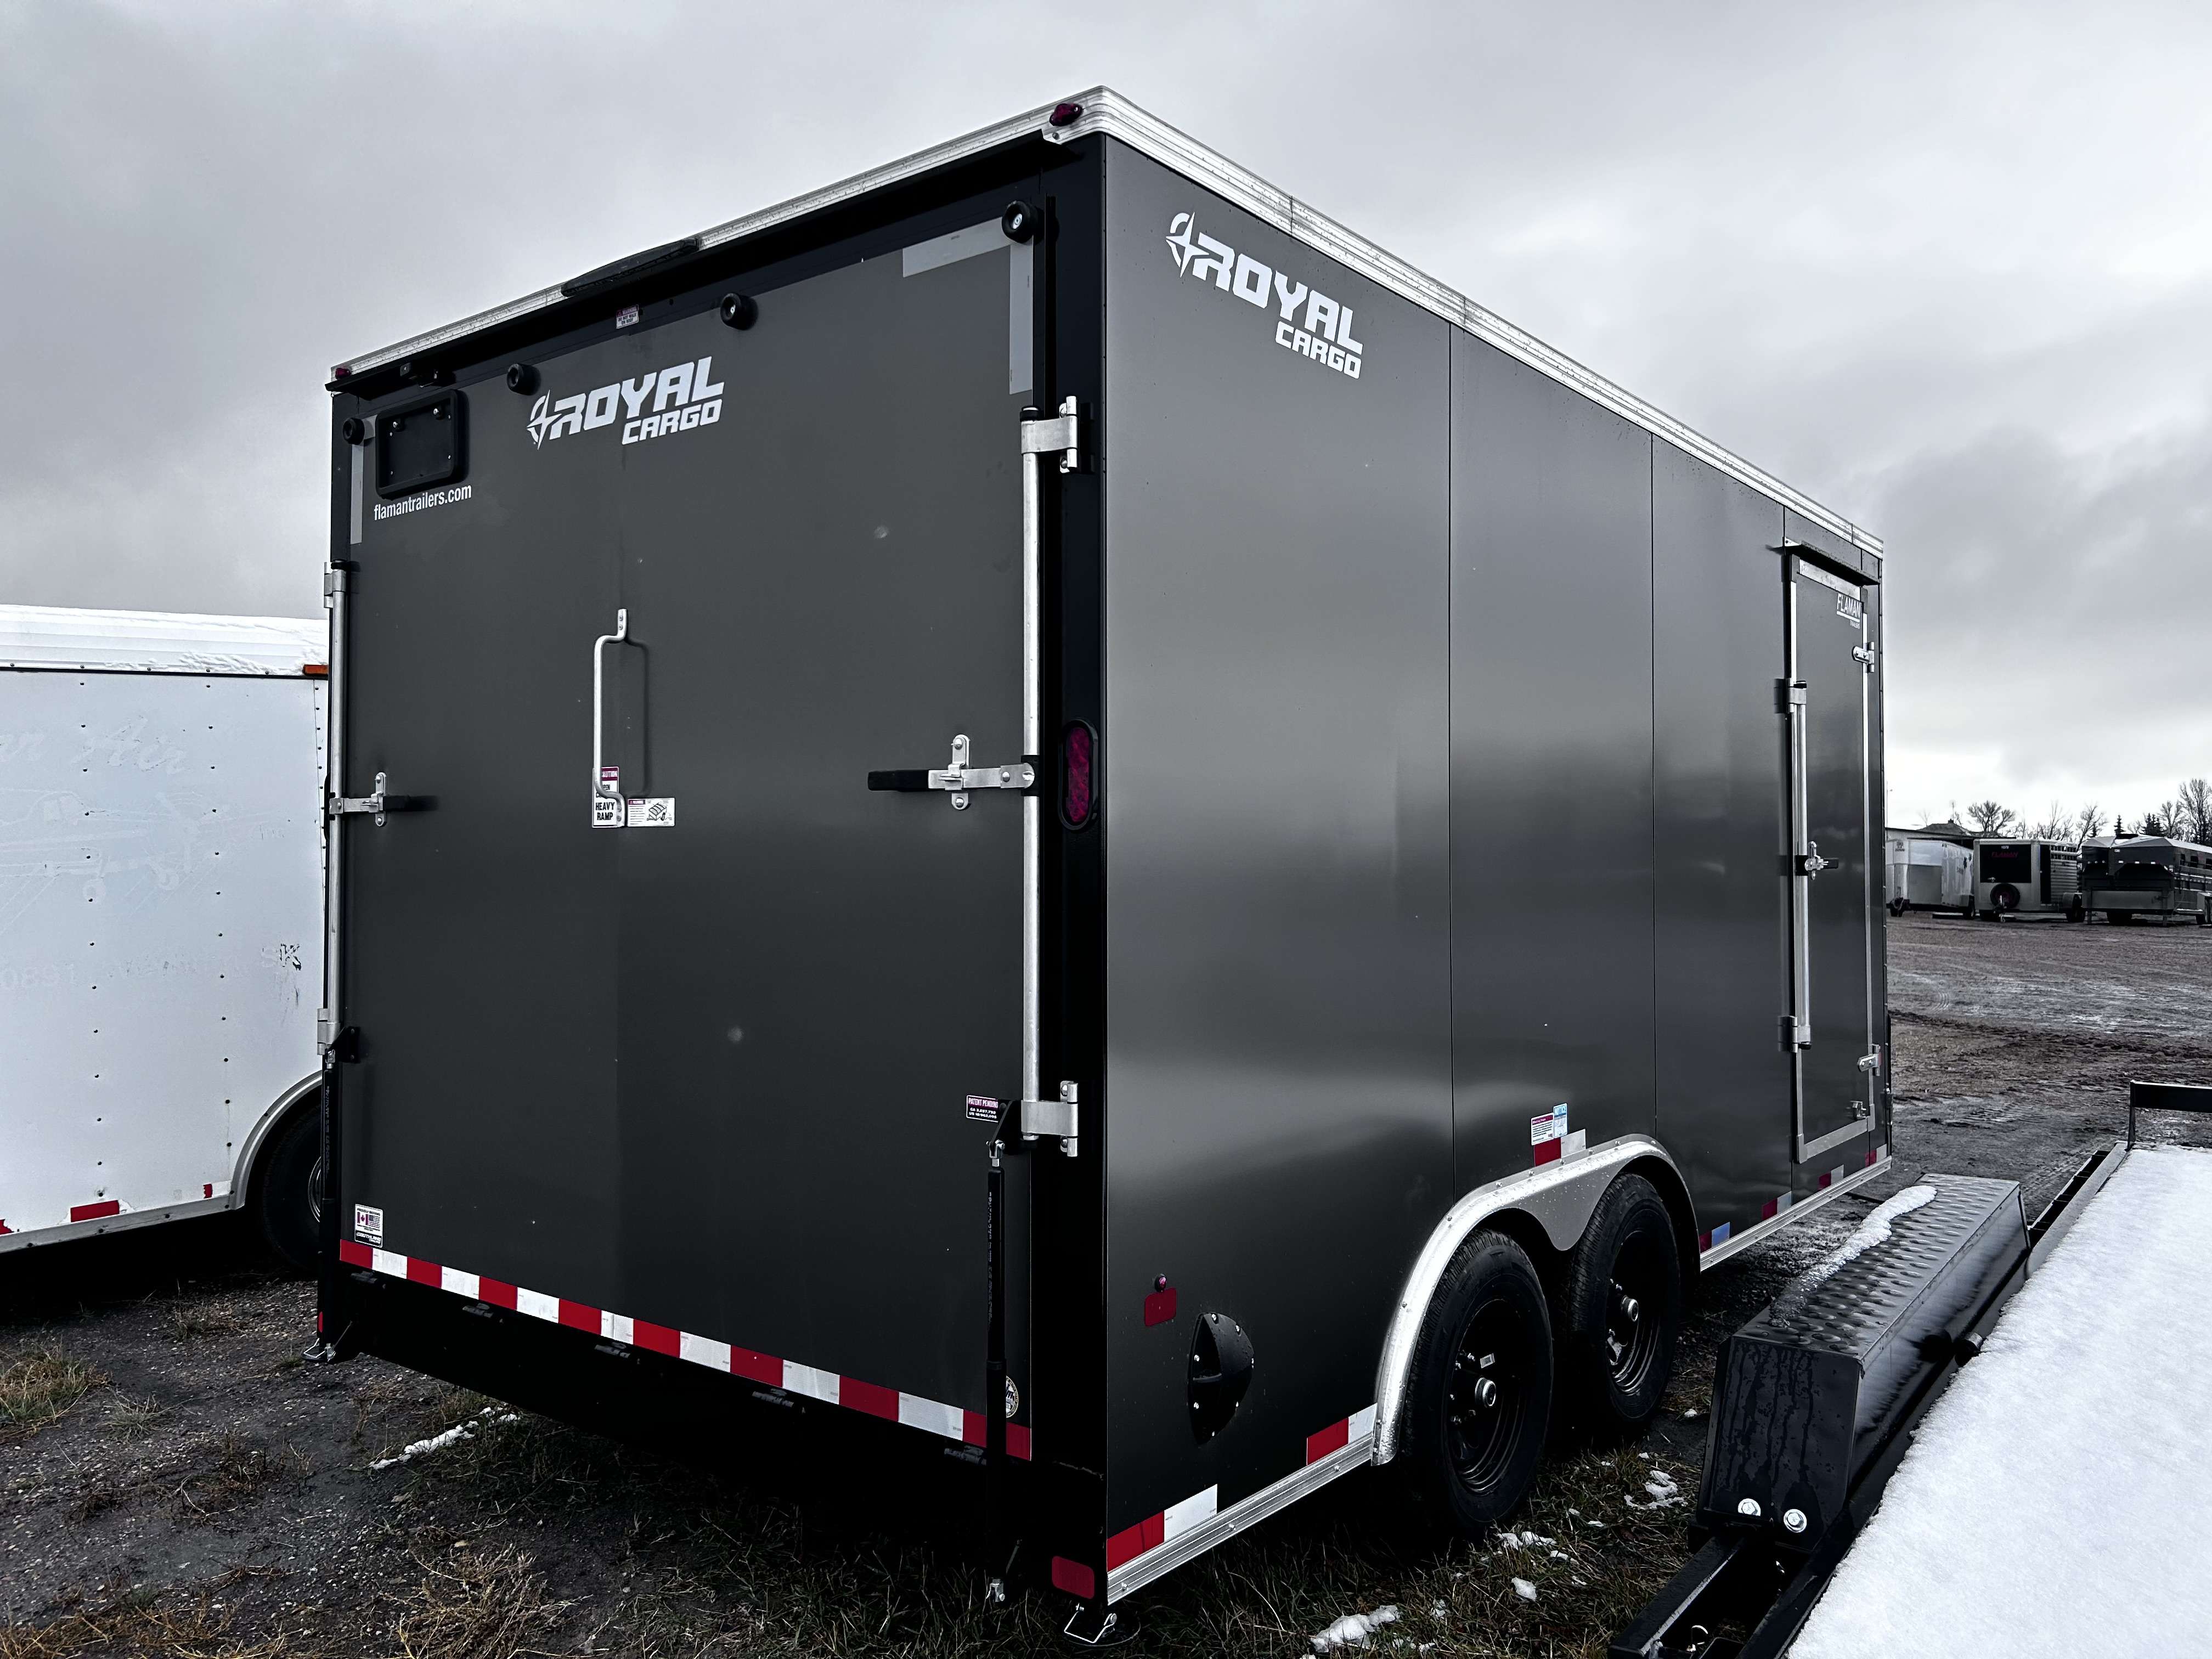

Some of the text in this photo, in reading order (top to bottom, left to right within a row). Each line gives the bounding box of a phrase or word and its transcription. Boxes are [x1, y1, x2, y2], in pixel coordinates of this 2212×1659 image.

[1192, 232, 1363, 355] ROYAL
[1275, 321, 1362, 379] CARGO
[549, 357, 724, 440] ROYAL
[622, 399, 722, 445] CARGO
[374, 485, 472, 521] flamantrailers.com
[1837, 593, 1861, 618] FLAMAN
[595, 802, 615, 811] HEAVY
[597, 812, 613, 821] RAMP
[968, 1097, 998, 1109] PATENT PENDING
